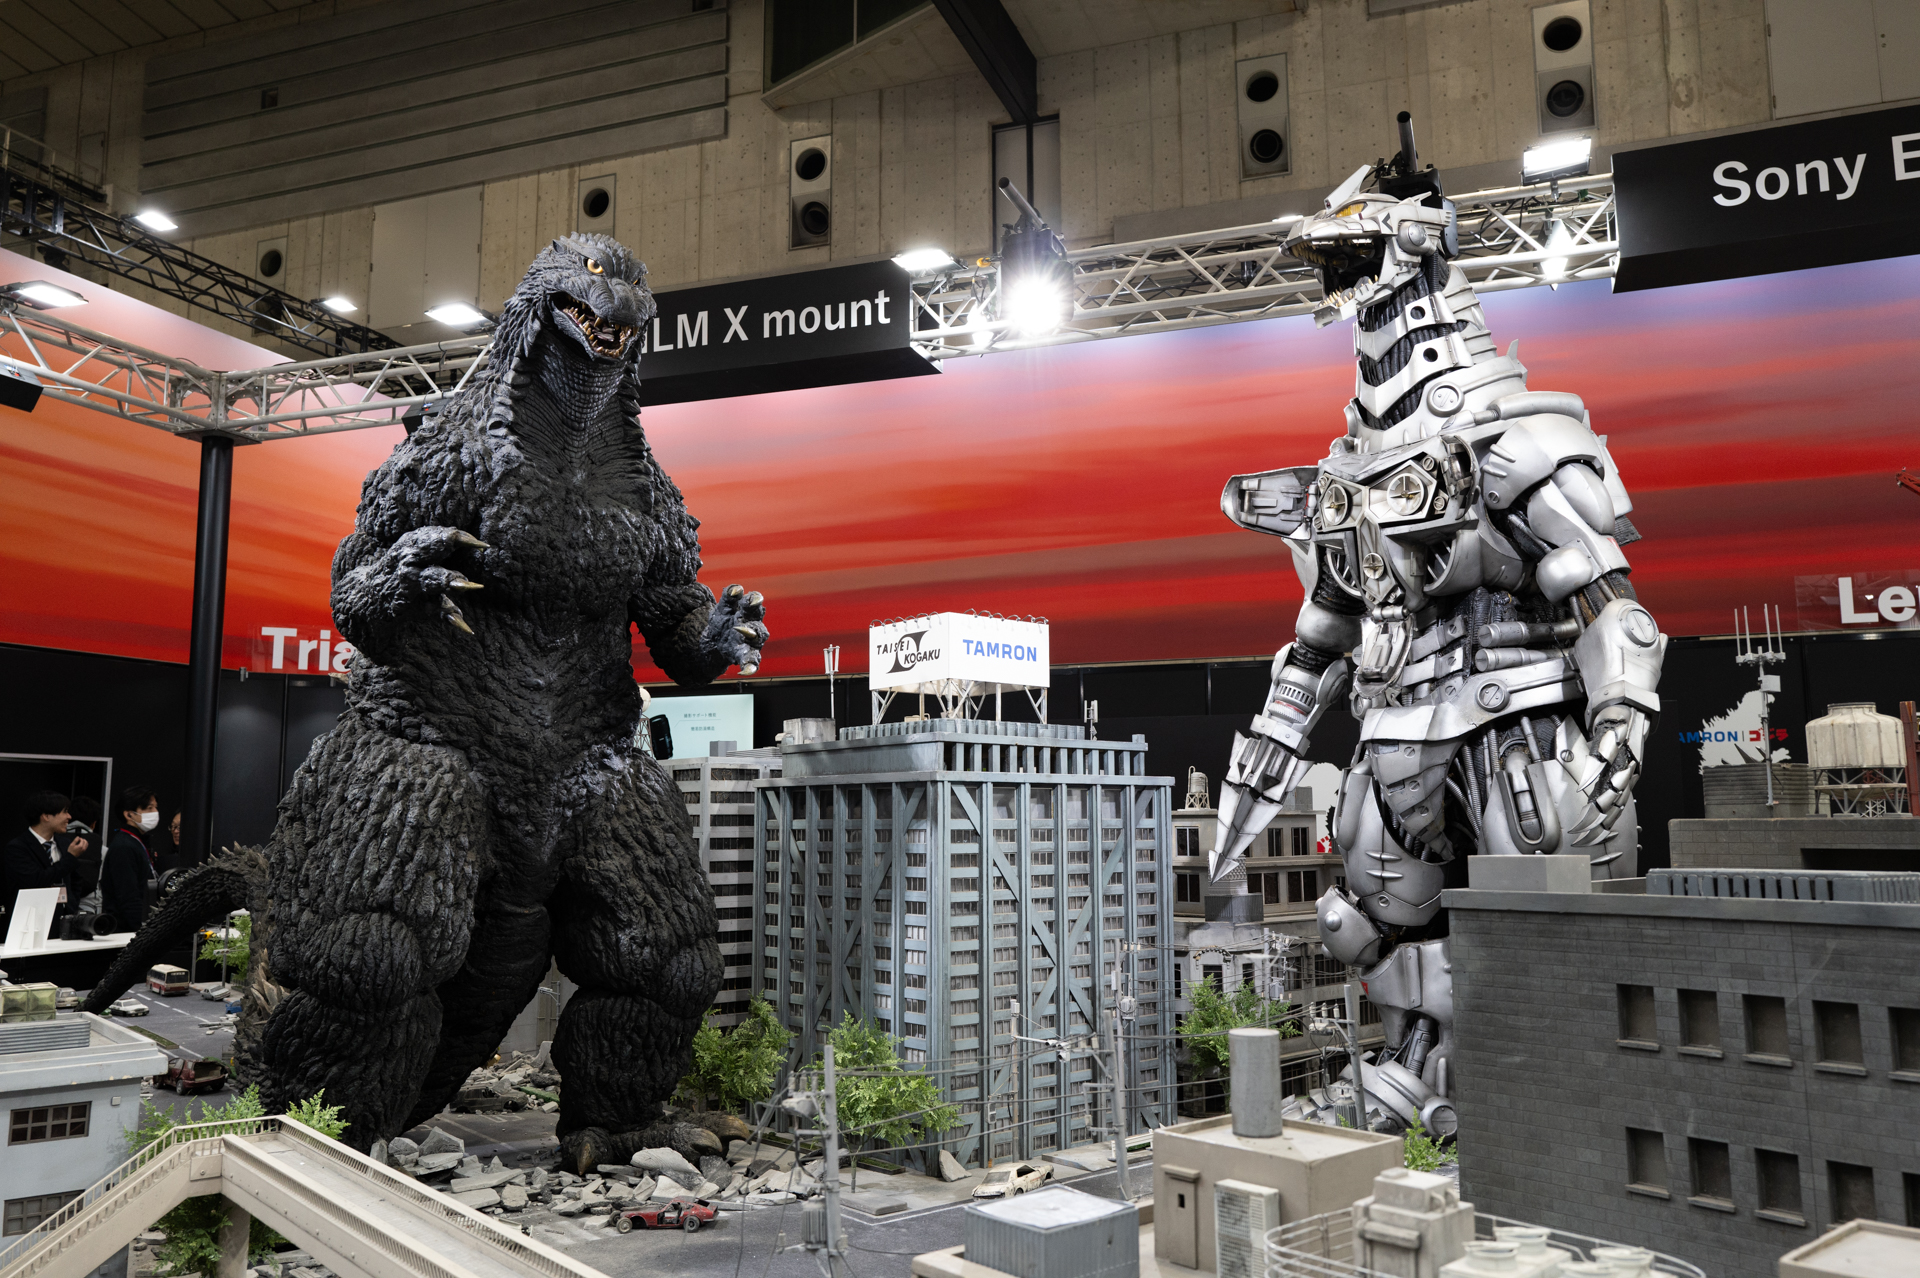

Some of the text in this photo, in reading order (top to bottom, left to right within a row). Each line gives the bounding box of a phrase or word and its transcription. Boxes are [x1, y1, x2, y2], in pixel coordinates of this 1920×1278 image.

[1712, 132, 1920, 207] Sony E
[722, 305, 749, 343] X
[763, 289, 891, 339] mount
[1838, 577, 1920, 624] Le
[261, 626, 357, 673] Tria
[877, 640, 910, 655] TAISEI
[904, 649, 941, 665] KOGAKU
[962, 639, 1037, 662] TAMRON
